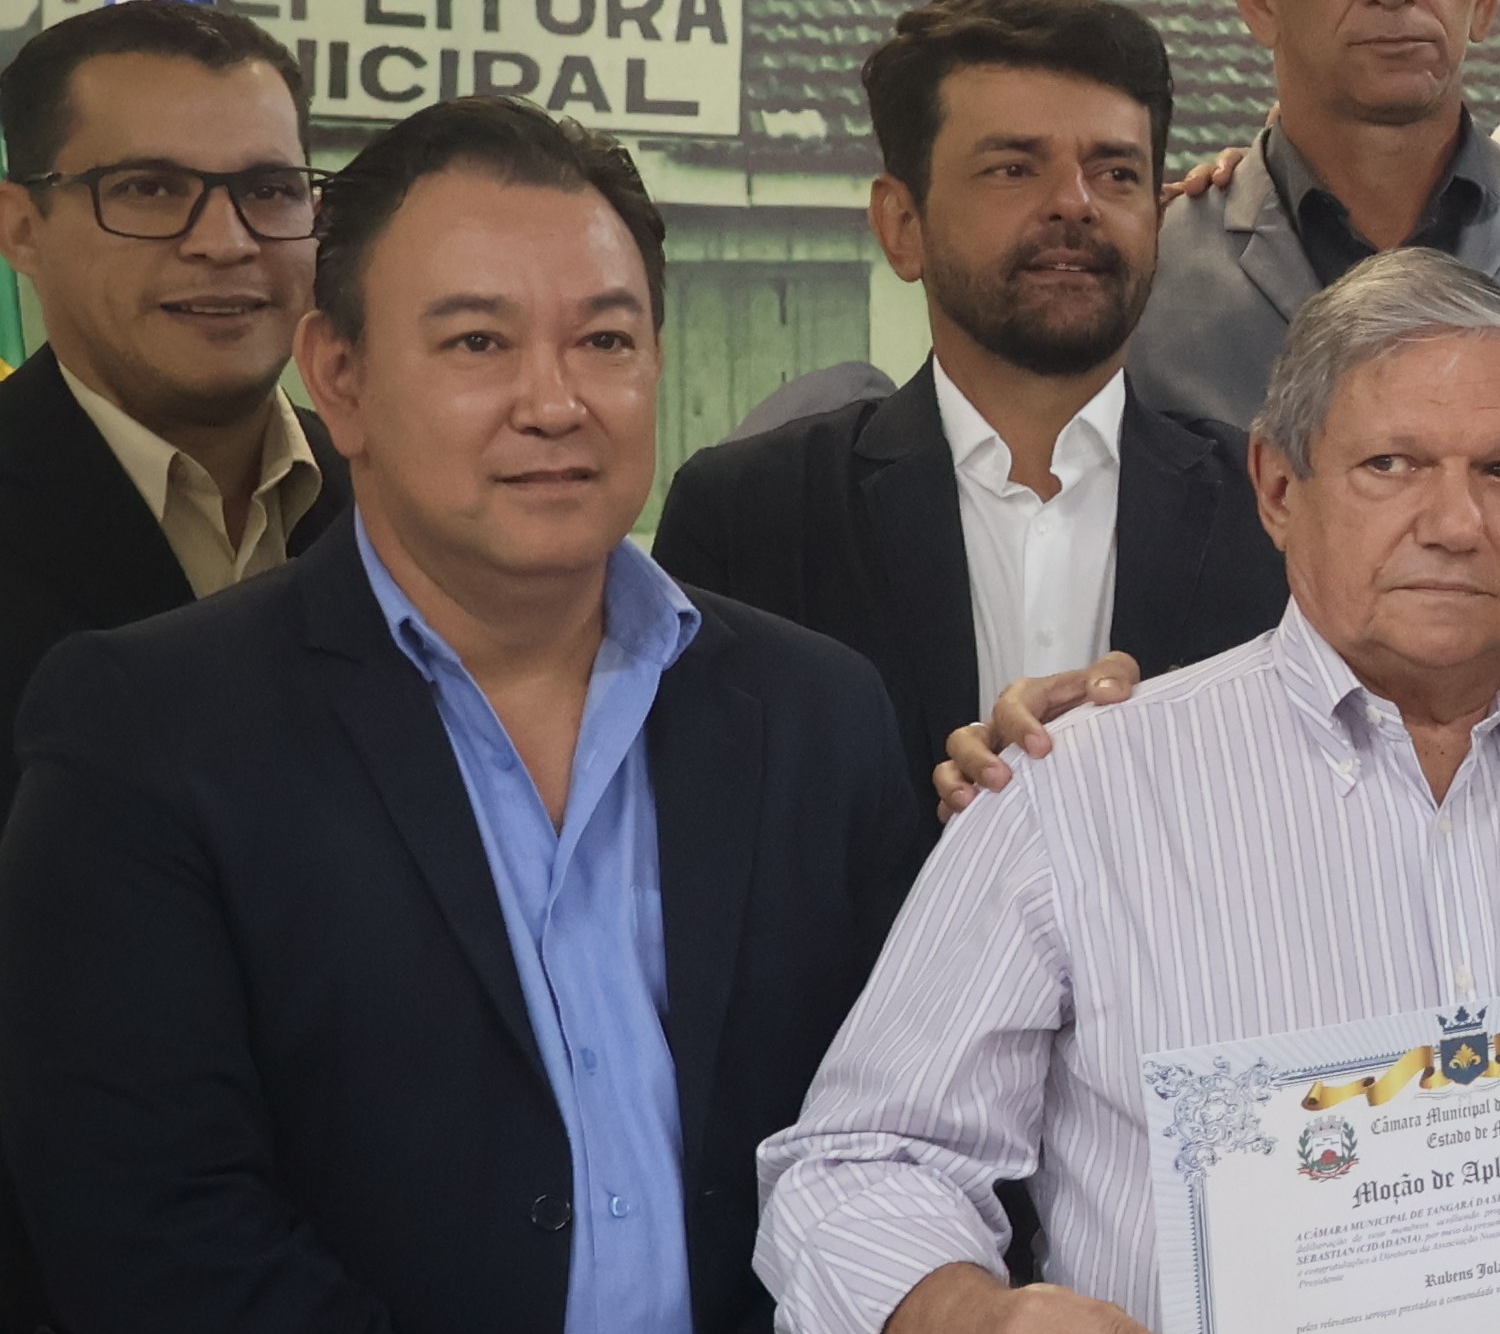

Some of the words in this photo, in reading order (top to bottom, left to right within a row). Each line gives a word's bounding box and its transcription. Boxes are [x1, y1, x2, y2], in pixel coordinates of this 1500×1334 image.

[1371, 1115, 1421, 1135] Câmara
[1426, 1099, 1490, 1126] Municipal
[1353, 1169, 1424, 1208] Moção
[1431, 1170, 1454, 1189] de
[1425, 1268, 1473, 1288] Rubens
